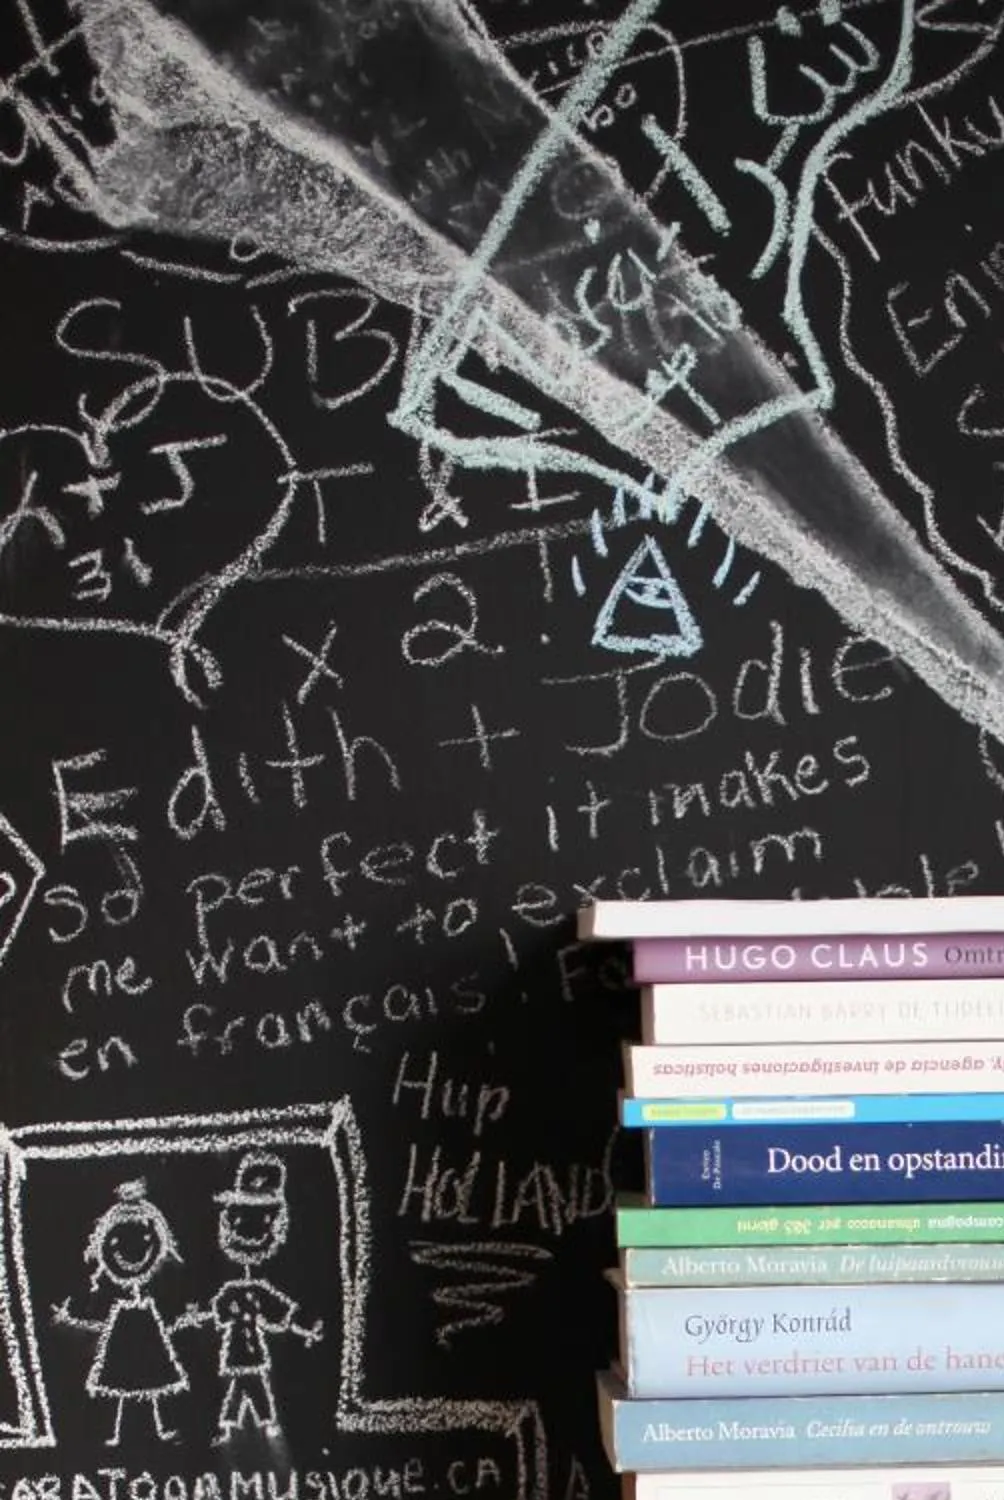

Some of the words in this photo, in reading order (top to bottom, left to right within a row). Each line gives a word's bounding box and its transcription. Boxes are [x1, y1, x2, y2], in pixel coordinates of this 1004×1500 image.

[649, 735, 870, 824] makes
[186, 913, 369, 985] want
[395, 898, 478, 945] to
[685, 944, 797, 971] HUGO
[811, 942, 930, 969] CLAUS
[699, 1001, 812, 1022] SEBASTIAN
[822, 1001, 886, 1021] BARRY
[743, 1058, 879, 1078] investigaciones
[885, 1058, 906, 1074] de
[767, 1146, 843, 1173] Dood
[850, 1152, 881, 1172] en
[660, 1254, 741, 1277] Alberto
[748, 1254, 828, 1276] Moravia
[840, 1254, 862, 1274] De
[684, 1313, 766, 1344] György
[772, 1306, 853, 1333] Konrád
[686, 1353, 731, 1378] Het
[743, 1349, 846, 1376] verdriet
[852, 1354, 898, 1373] van
[906, 1345, 936, 1371] de
[642, 1421, 714, 1443] Alberto
[718, 1420, 796, 1441] Moravia
[868, 1423, 890, 1438] en
[893, 1418, 913, 1437] de
